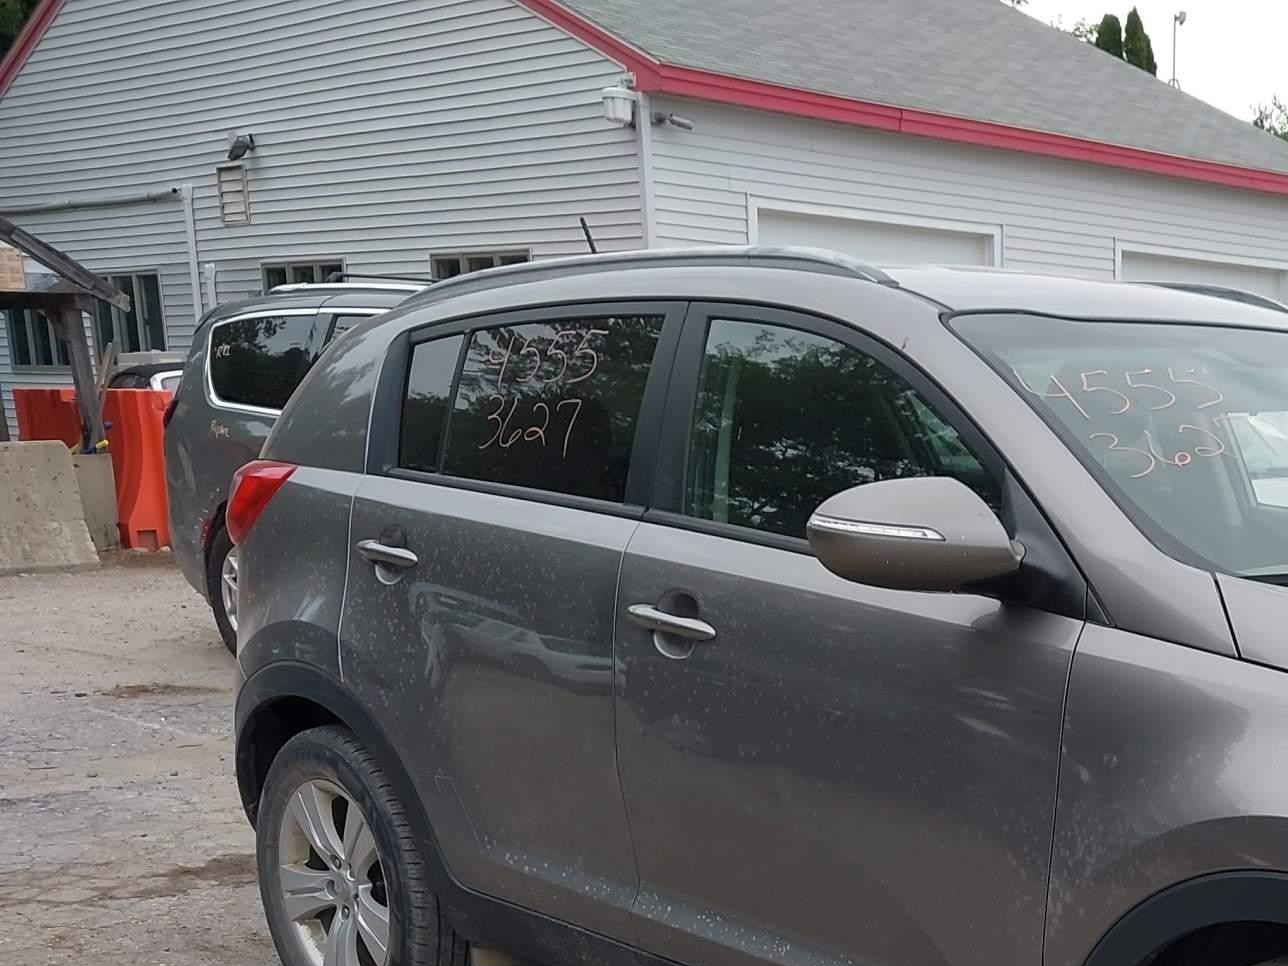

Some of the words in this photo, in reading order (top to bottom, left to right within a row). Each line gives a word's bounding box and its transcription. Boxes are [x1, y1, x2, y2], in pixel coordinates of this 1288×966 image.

[488, 329, 610, 394] 4555
[1012, 367, 1224, 420] 4555
[478, 394, 583, 459] 3627
